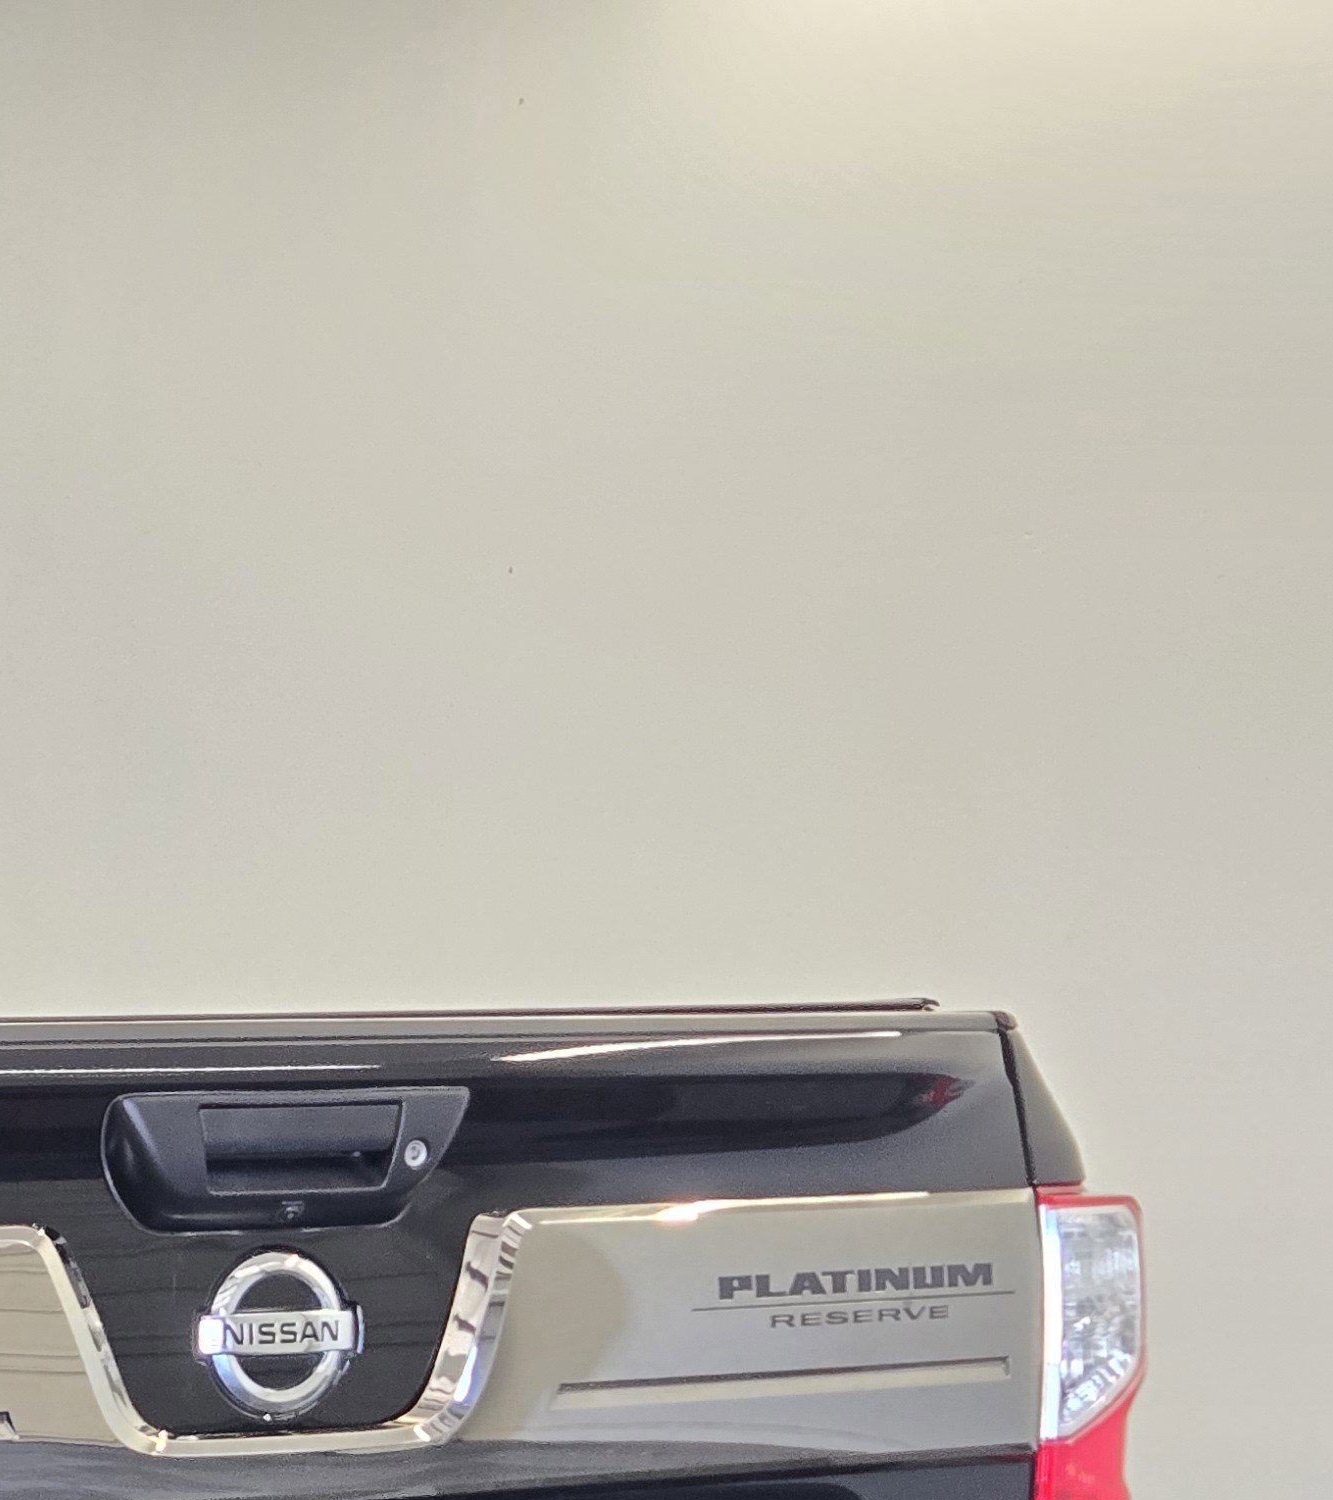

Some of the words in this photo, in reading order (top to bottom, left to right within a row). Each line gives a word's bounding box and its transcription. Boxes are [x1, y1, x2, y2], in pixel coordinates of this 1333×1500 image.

[718, 1263, 993, 1300] PLATINUM
[770, 1305, 949, 1328] RESERVE
[224, 1320, 339, 1345] NISSAN
